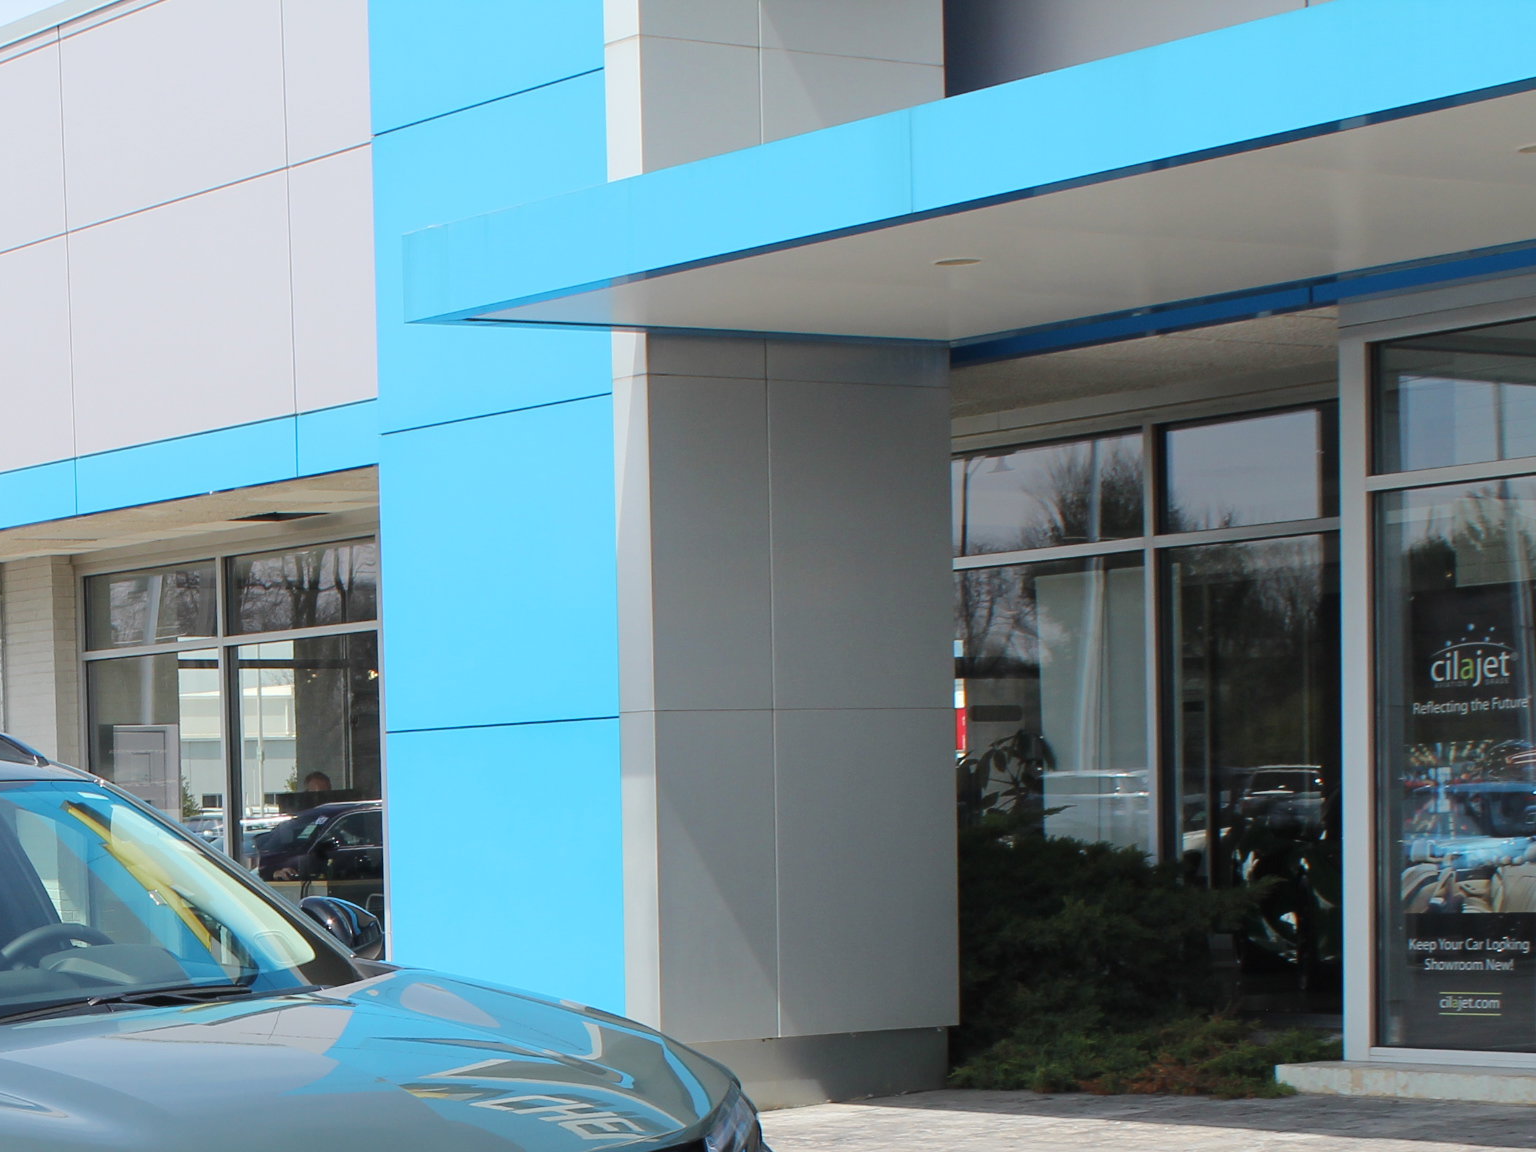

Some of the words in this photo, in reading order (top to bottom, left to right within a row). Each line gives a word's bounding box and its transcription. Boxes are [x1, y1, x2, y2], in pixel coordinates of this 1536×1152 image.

[1430, 650, 1511, 687] cilajet
[1412, 700, 1469, 715] Reflecting
[1470, 698, 1491, 711] the
[1491, 697, 1529, 710] Future
[1408, 938, 1438, 953] Keep
[1438, 938, 1464, 951] Your
[1465, 938, 1485, 951] Car
[1486, 938, 1531, 953] Looking
[1424, 958, 1484, 971] Showroom
[1485, 958, 1515, 971] New!
[1439, 996, 1500, 1012] cilajet.com
